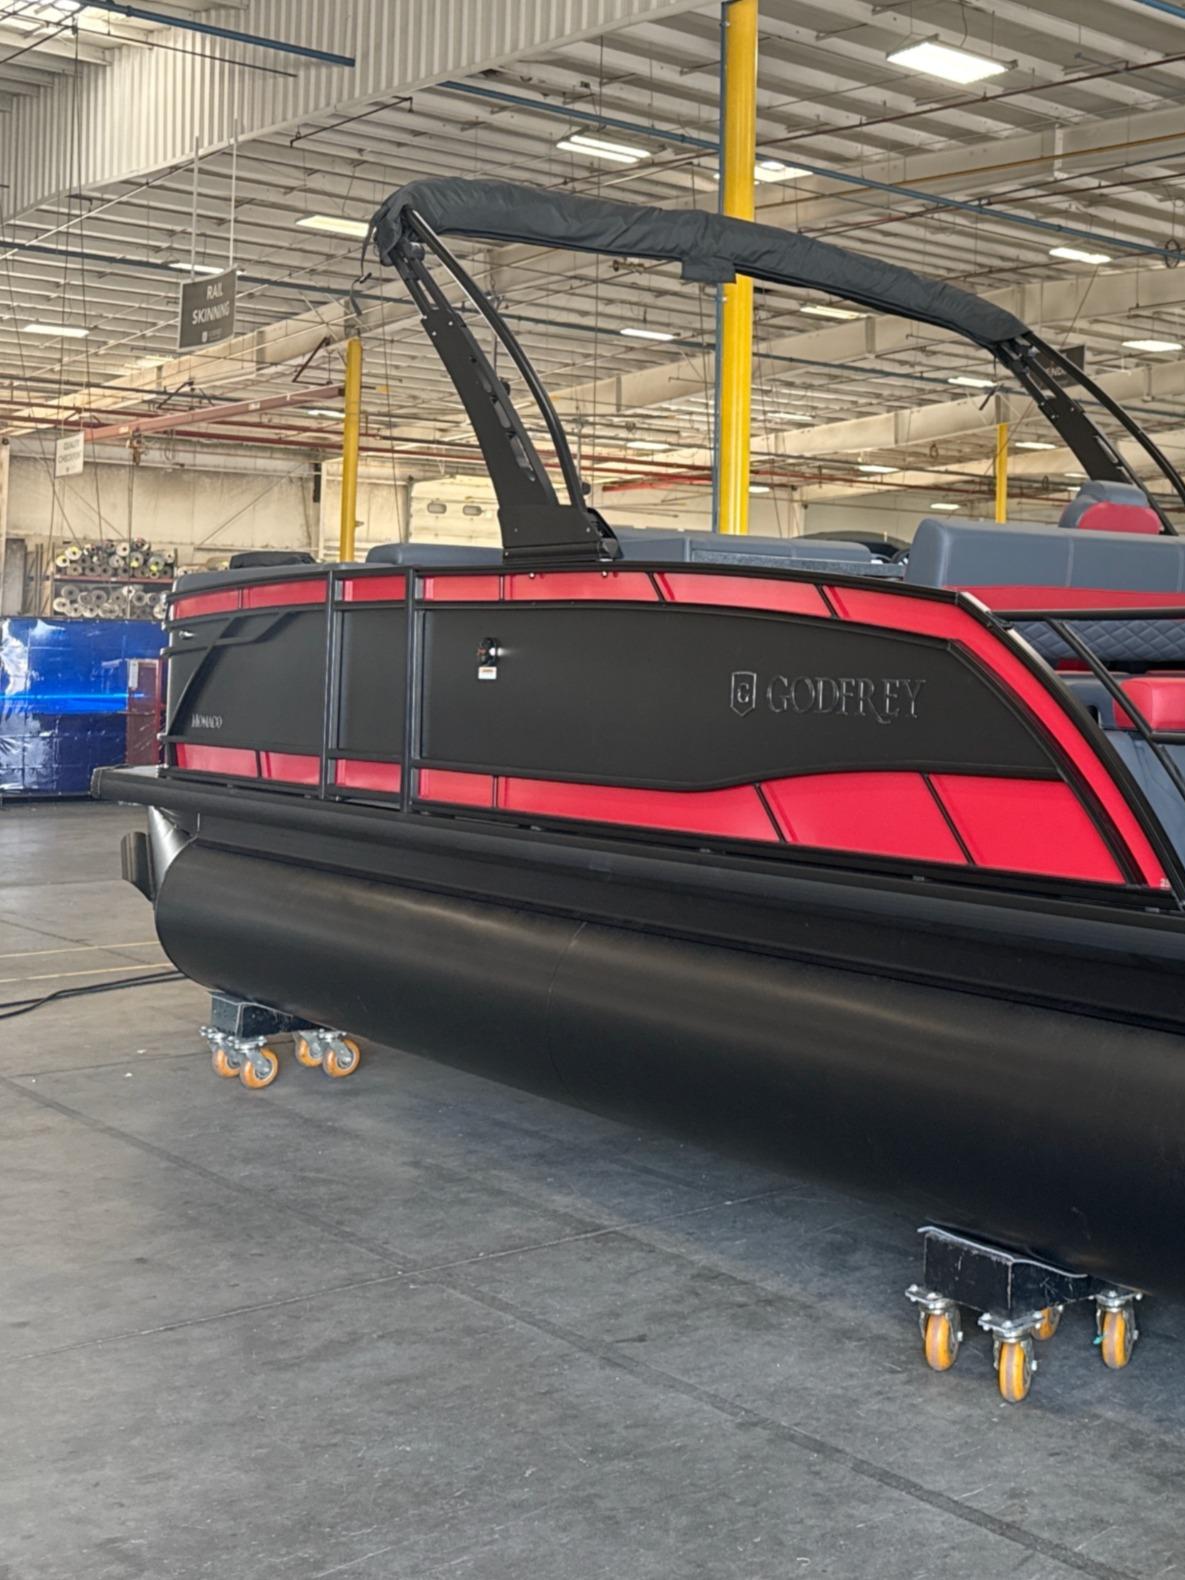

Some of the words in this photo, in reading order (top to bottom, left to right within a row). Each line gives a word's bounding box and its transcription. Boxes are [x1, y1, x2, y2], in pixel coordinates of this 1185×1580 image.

[206, 282, 223, 300] RAIL
[192, 301, 230, 325] SKINNING
[766, 675, 926, 724] GODFREY
